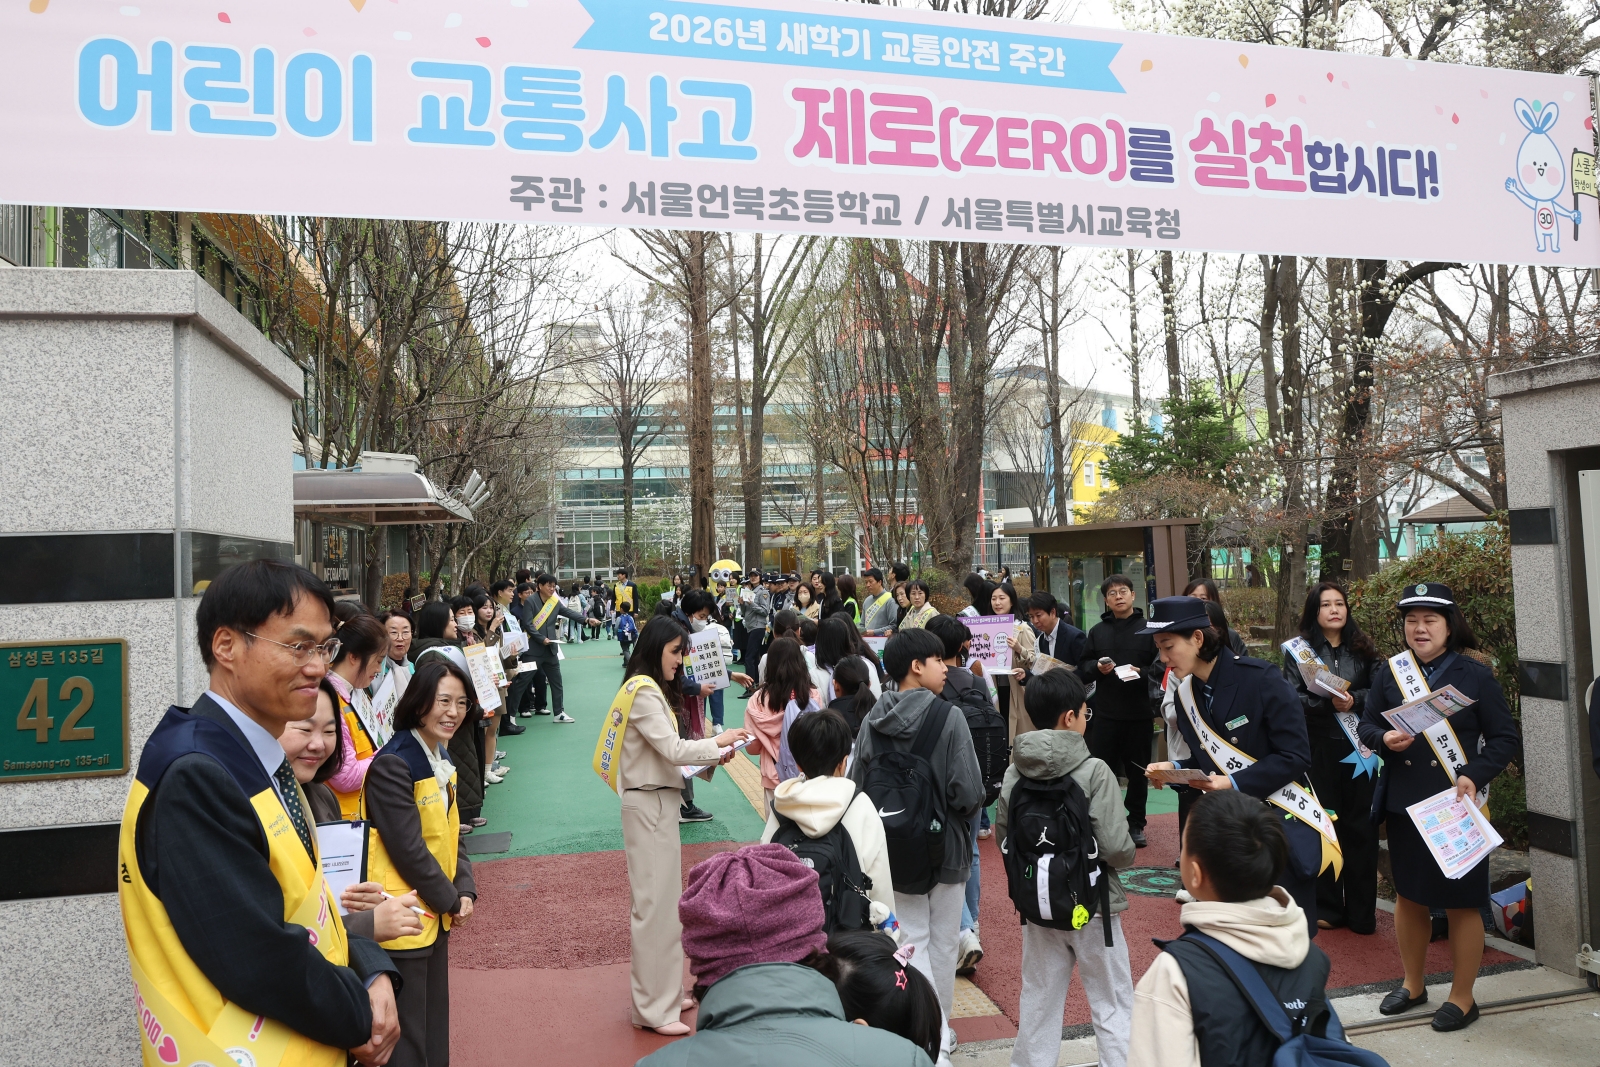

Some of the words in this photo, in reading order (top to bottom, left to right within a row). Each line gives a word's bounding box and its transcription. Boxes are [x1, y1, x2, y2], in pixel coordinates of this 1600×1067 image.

[648, 12, 767, 52] 2026년
[776, 22, 871, 60] 새학기
[881, 31, 1002, 72] 교통안전
[1009, 43, 1067, 78] 주간
[77, 37, 375, 143] 어린이
[407, 60, 758, 161] 교통사고
[791, 86, 1175, 184] 제로(ZERO)를
[1188, 117, 1440, 200] 실천합시다!
[509, 174, 586, 213] 주관
[621, 180, 902, 226] 서울언북초등학교
[914, 195, 930, 226] /
[941, 196, 1181, 240] 서울특별시교육청
[1539, 212, 1552, 225] 30
[8, 651, 55, 668] 삼성로
[59, 648, 104, 664] 135길
[16, 676, 95, 743] 42
[3, 758, 71, 770] Samseong-ro
[75, 754, 110, 767] 135-gil
[1201, 730, 1221, 754] 우리
